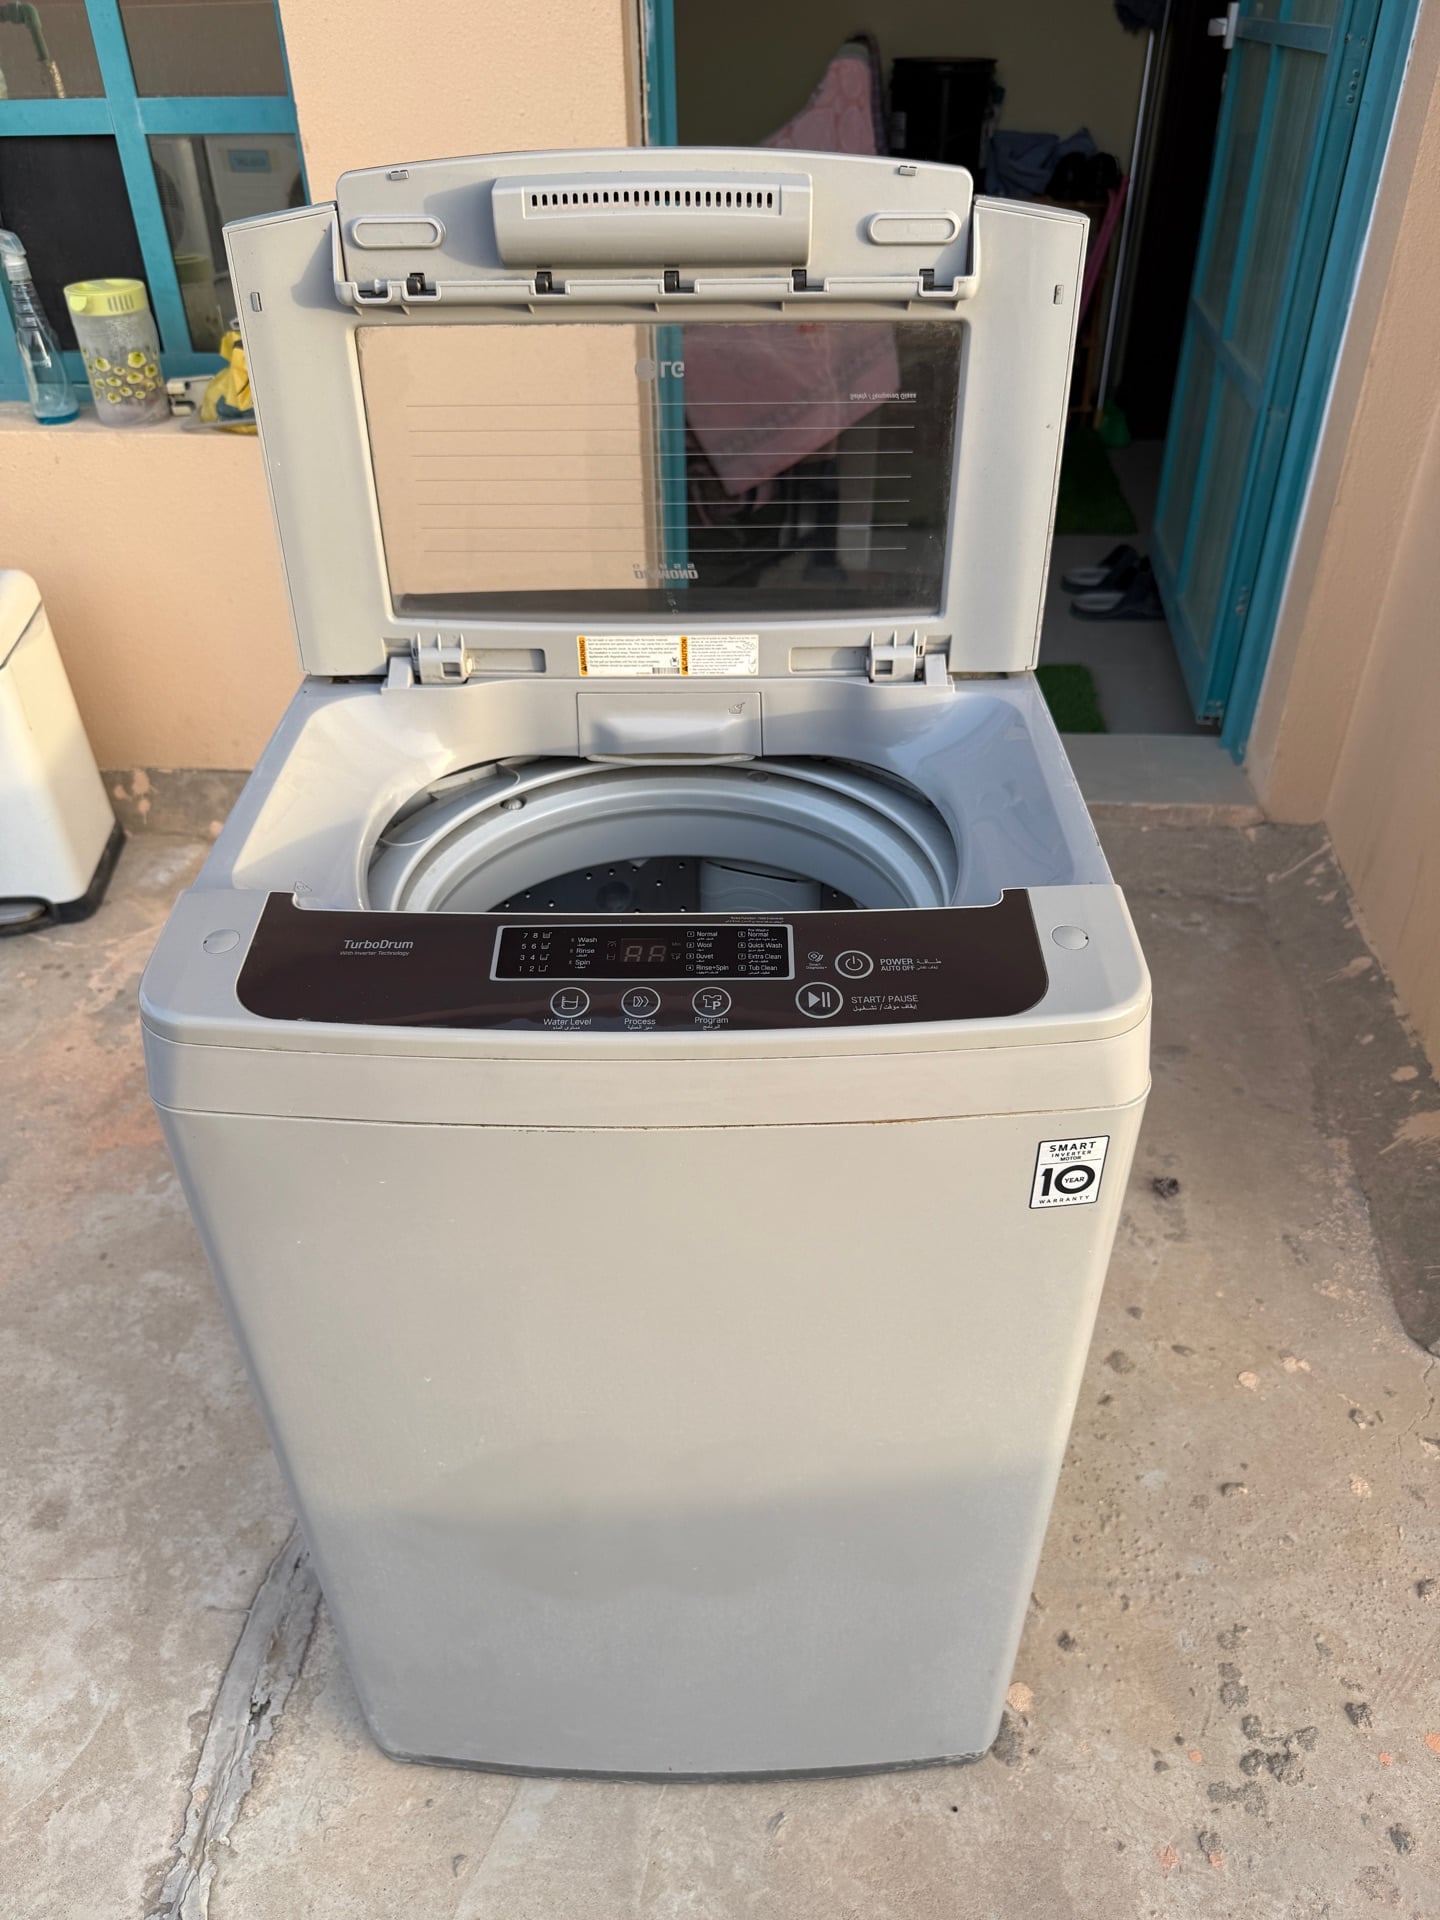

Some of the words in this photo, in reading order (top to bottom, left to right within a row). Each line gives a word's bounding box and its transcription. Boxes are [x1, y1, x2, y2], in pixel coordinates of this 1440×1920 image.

[344, 939, 414, 949] TurboDrum
[851, 995, 882, 1003] START
[888, 994, 919, 1003] PAUSE
[543, 1018, 568, 1026] Water
[570, 1017, 592, 1026] Level
[624, 1017, 656, 1025] Process
[695, 1016, 729, 1026] Program
[1049, 1141, 1097, 1153] SMART
[1051, 1150, 1092, 1158] INVERTER
[1041, 1164, 1096, 1196] 10
[1064, 1176, 1085, 1184] YEAR
[1039, 1194, 1090, 1204] WARRANTY
